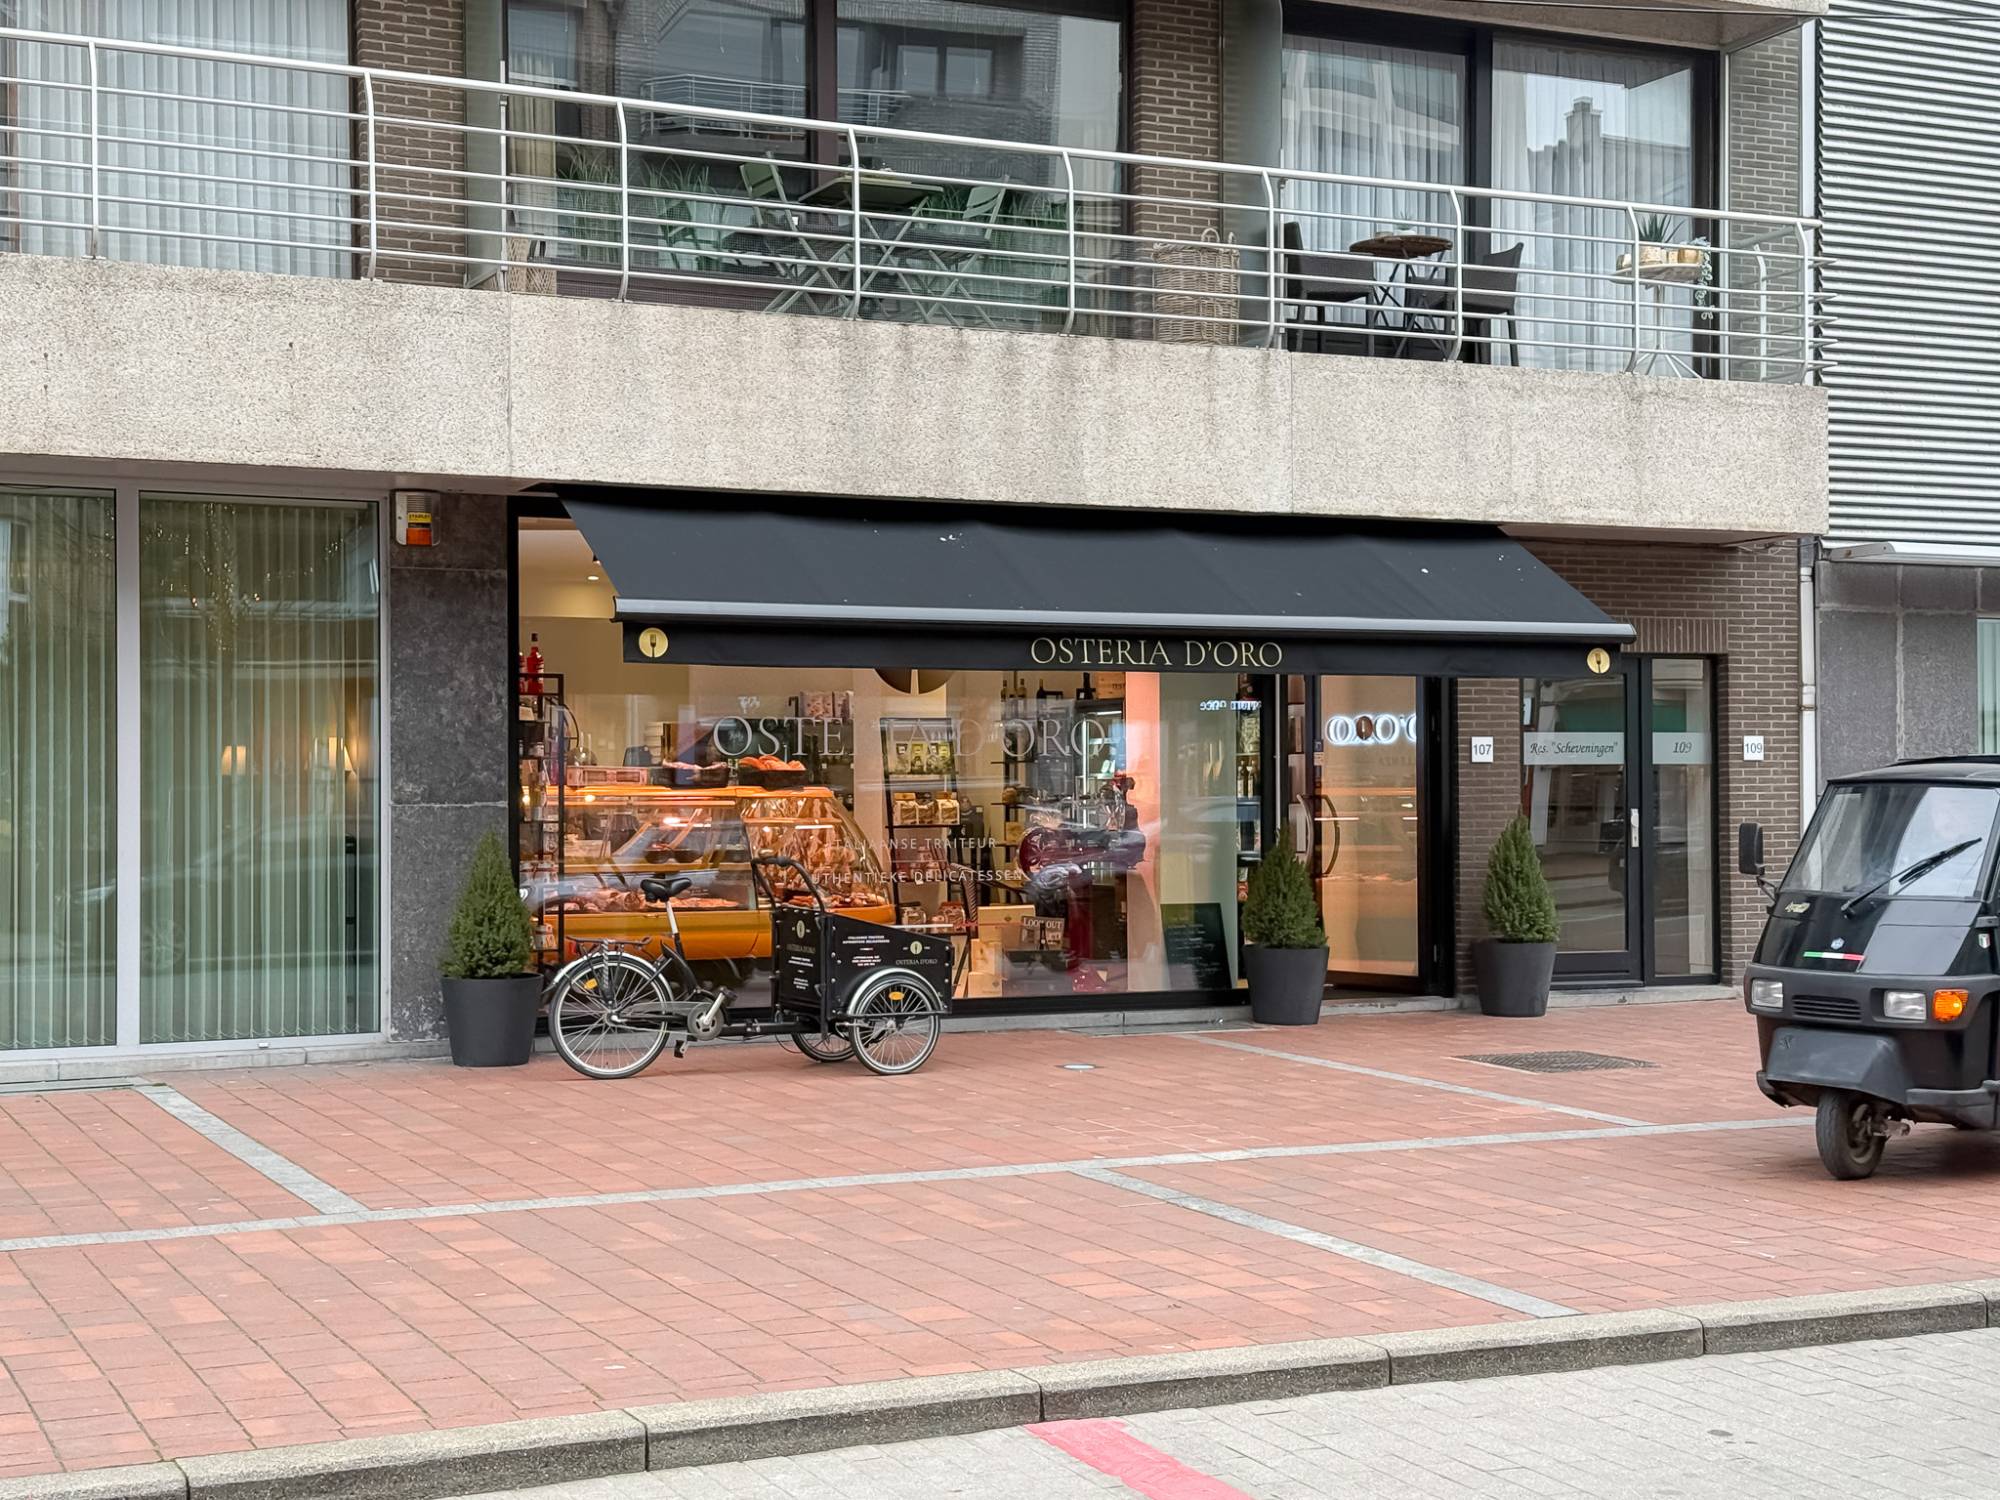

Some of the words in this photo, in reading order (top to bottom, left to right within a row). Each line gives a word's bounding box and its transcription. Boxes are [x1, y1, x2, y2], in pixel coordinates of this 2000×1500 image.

[1030, 637, 1173, 666] OSTERIA
[1184, 640, 1283, 668] D'ORO
[1473, 743, 1492, 756] 107
[1673, 742, 1693, 754] 109
[1744, 743, 1763, 754] 109
[924, 837, 997, 849] TRAITEUR
[812, 871, 907, 884] UTHENTIEKE
[914, 869, 1022, 883] DELICATESSEN
[1046, 920, 1062, 929] OUT
